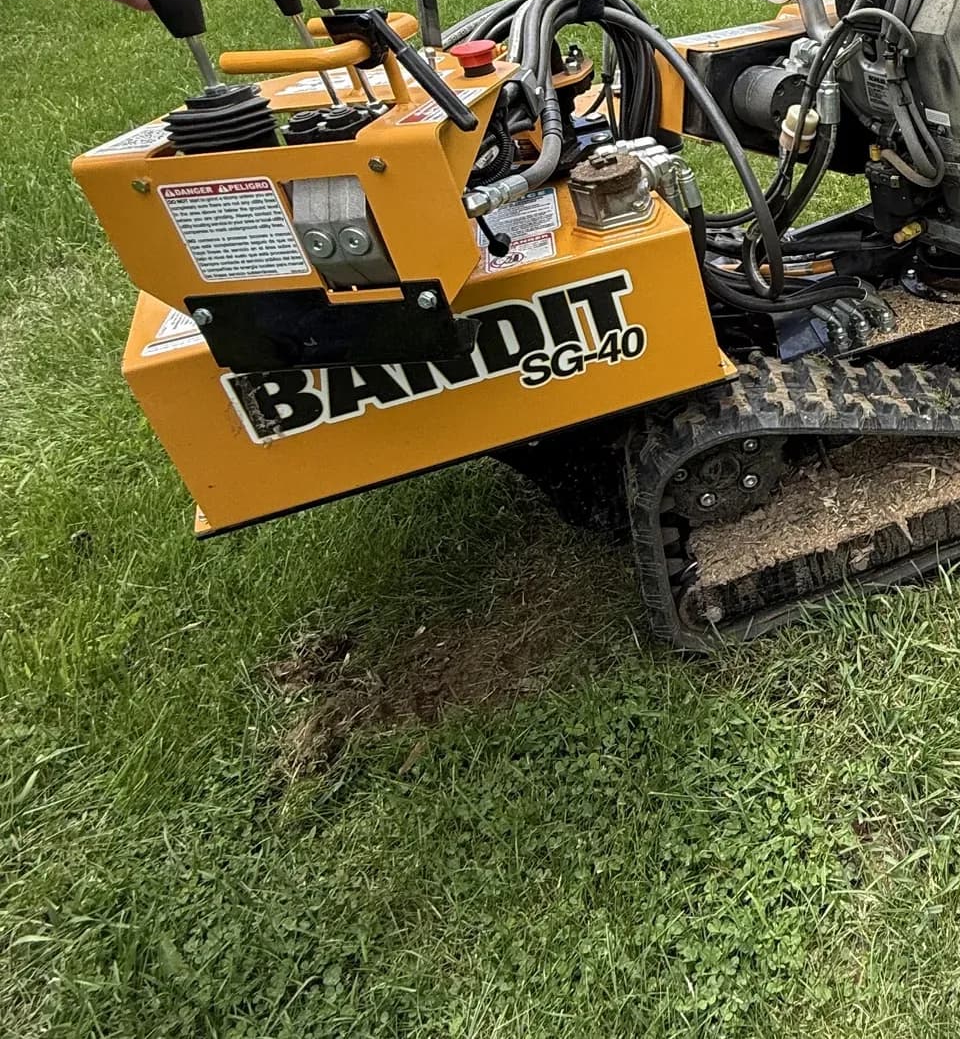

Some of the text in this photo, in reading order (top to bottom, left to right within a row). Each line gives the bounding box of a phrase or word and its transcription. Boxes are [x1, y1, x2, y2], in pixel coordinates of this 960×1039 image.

[174, 181, 269, 196] DANGER PELIGRO
[512, 234, 548, 246] ANGER
[521, 327, 645, 386] SG-40
